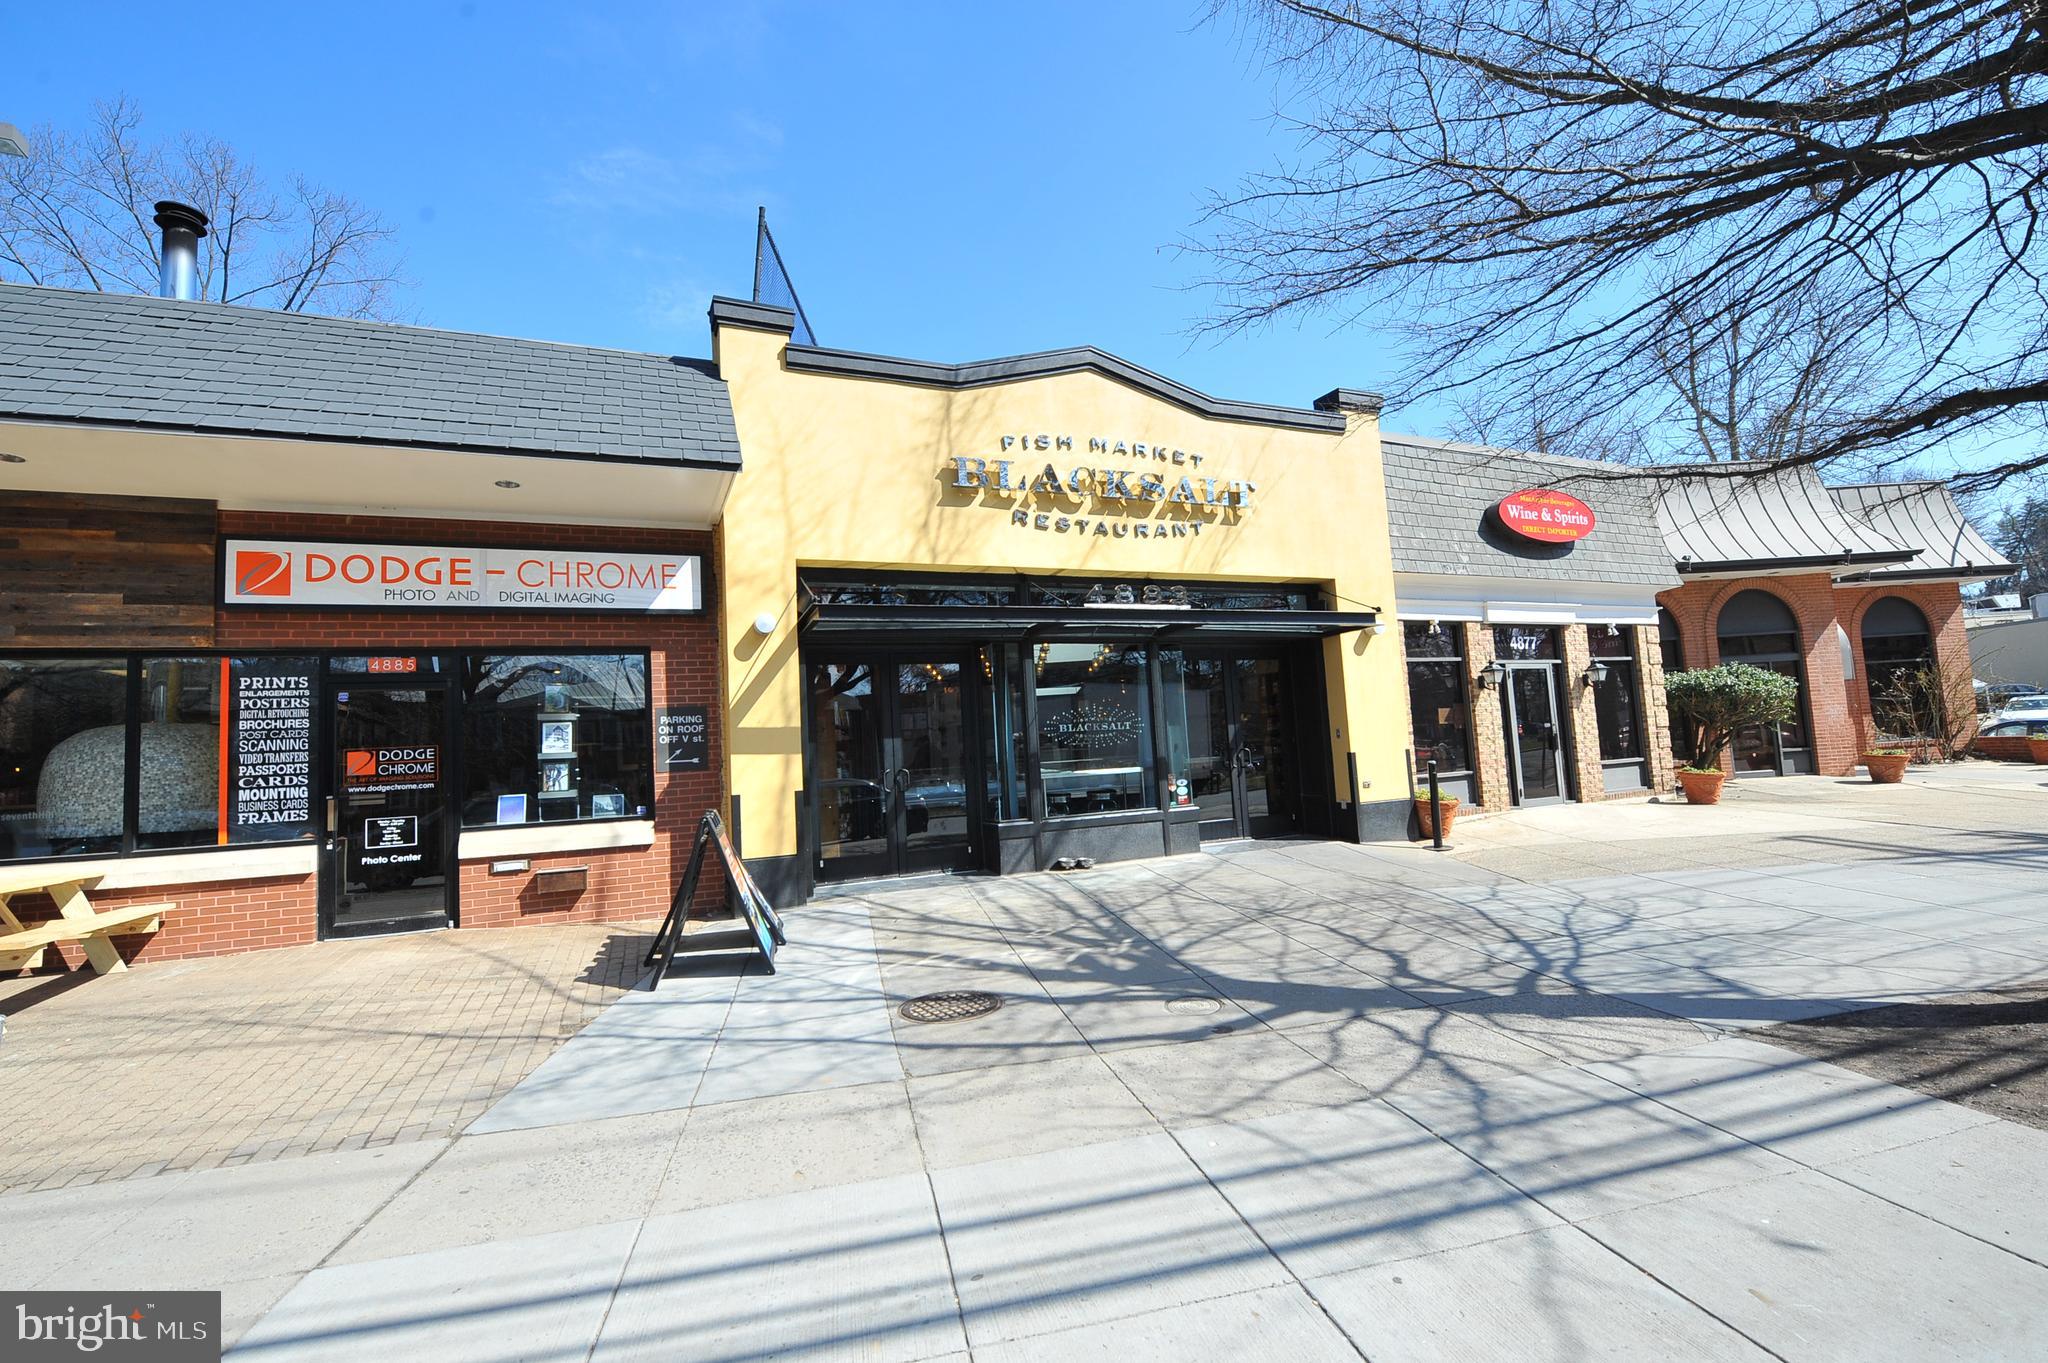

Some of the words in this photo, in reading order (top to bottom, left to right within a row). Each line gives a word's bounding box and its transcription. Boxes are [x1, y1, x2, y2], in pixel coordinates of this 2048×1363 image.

[1000, 435, 1073, 451] FISH
[1089, 437, 1204, 468] MARKET
[951, 456, 1256, 508] BLACKSALT
[1507, 504, 1538, 520] Wine
[1541, 507, 1552, 521] &
[1554, 508, 1588, 526] Spirits
[1011, 510, 1204, 539] RESTAURANT
[1522, 525, 1546, 534] DIRECT
[1547, 528, 1578, 537] IMPORTER
[306, 553, 472, 586] DODGE
[517, 559, 678, 590] CHROME
[384, 588, 436, 601] PHOTO
[446, 589, 480, 602] AND
[499, 590, 549, 603] DIGITAL
[553, 592, 615, 605] IMAGING
[1510, 636, 1537, 650] 4877
[371, 659, 415, 671] 4885
[239, 676, 309, 690] PRINTS
[239, 689, 310, 698] ENLARGEMENTS
[239, 697, 310, 710] POSTERS
[239, 710, 266, 719] DIGITAL
[267, 708, 309, 718] RETOUCHING
[660, 715, 702, 724] PARKING
[239, 719, 310, 730] BROCHURES
[658, 726, 673, 734] ON
[677, 725, 704, 733] ROOF
[1059, 721, 1132, 733] BLACKSALT
[239, 731, 267, 740] POST
[270, 729, 309, 739] CARDS
[659, 735, 679, 744] OFF
[682, 735, 689, 743] V
[239, 739, 309, 753] SCANNING
[239, 753, 263, 765] VIDEO
[264, 751, 309, 764] TRANSFERS
[379, 748, 435, 761] DODGE
[238, 763, 309, 777] PASSPORTS
[378, 762, 435, 776] CHROME
[238, 775, 309, 788] CARDS
[348, 783, 435, 793] www.dodgechrome.com
[238, 786, 309, 802] MOUNTING
[238, 800, 279, 812] BUSINESS
[281, 799, 309, 810] CARDS
[238, 809, 309, 825] FRAMES
[361, 856, 388, 865] Photo
[390, 853, 422, 863] Center
